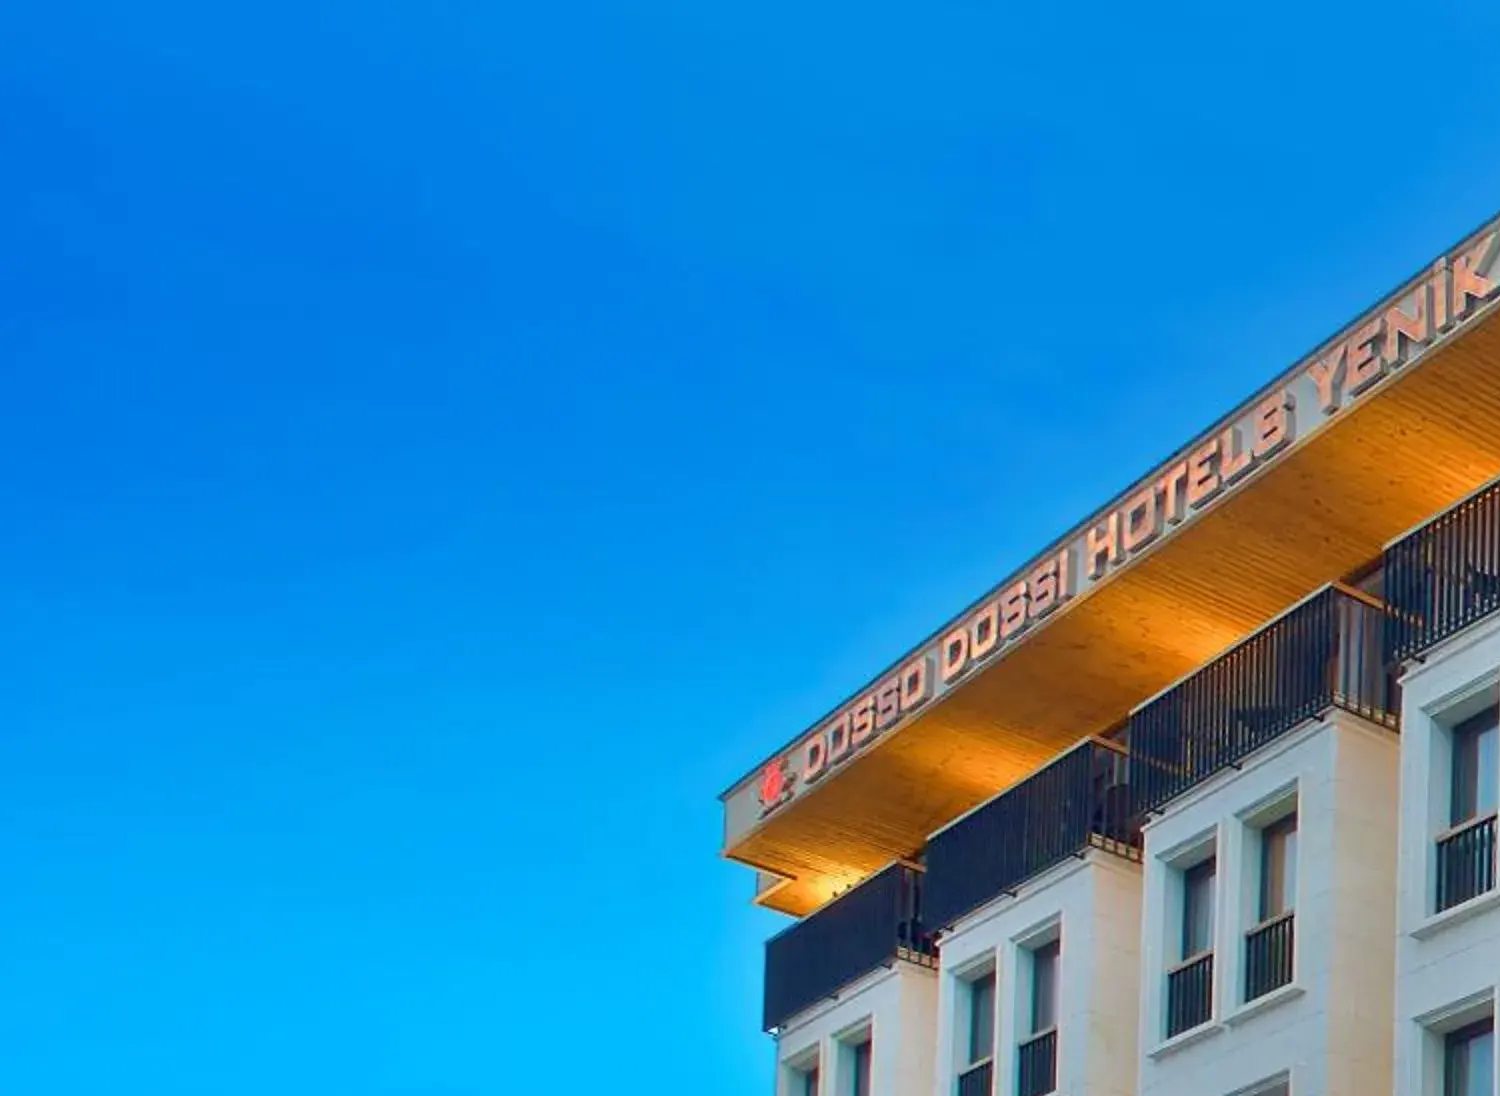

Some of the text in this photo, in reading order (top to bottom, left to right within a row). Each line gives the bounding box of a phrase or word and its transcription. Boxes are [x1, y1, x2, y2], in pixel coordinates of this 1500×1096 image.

[803, 655, 932, 783] DOSSO
[941, 548, 1073, 683] DOSSI
[1086, 389, 1291, 578] HOTELS
